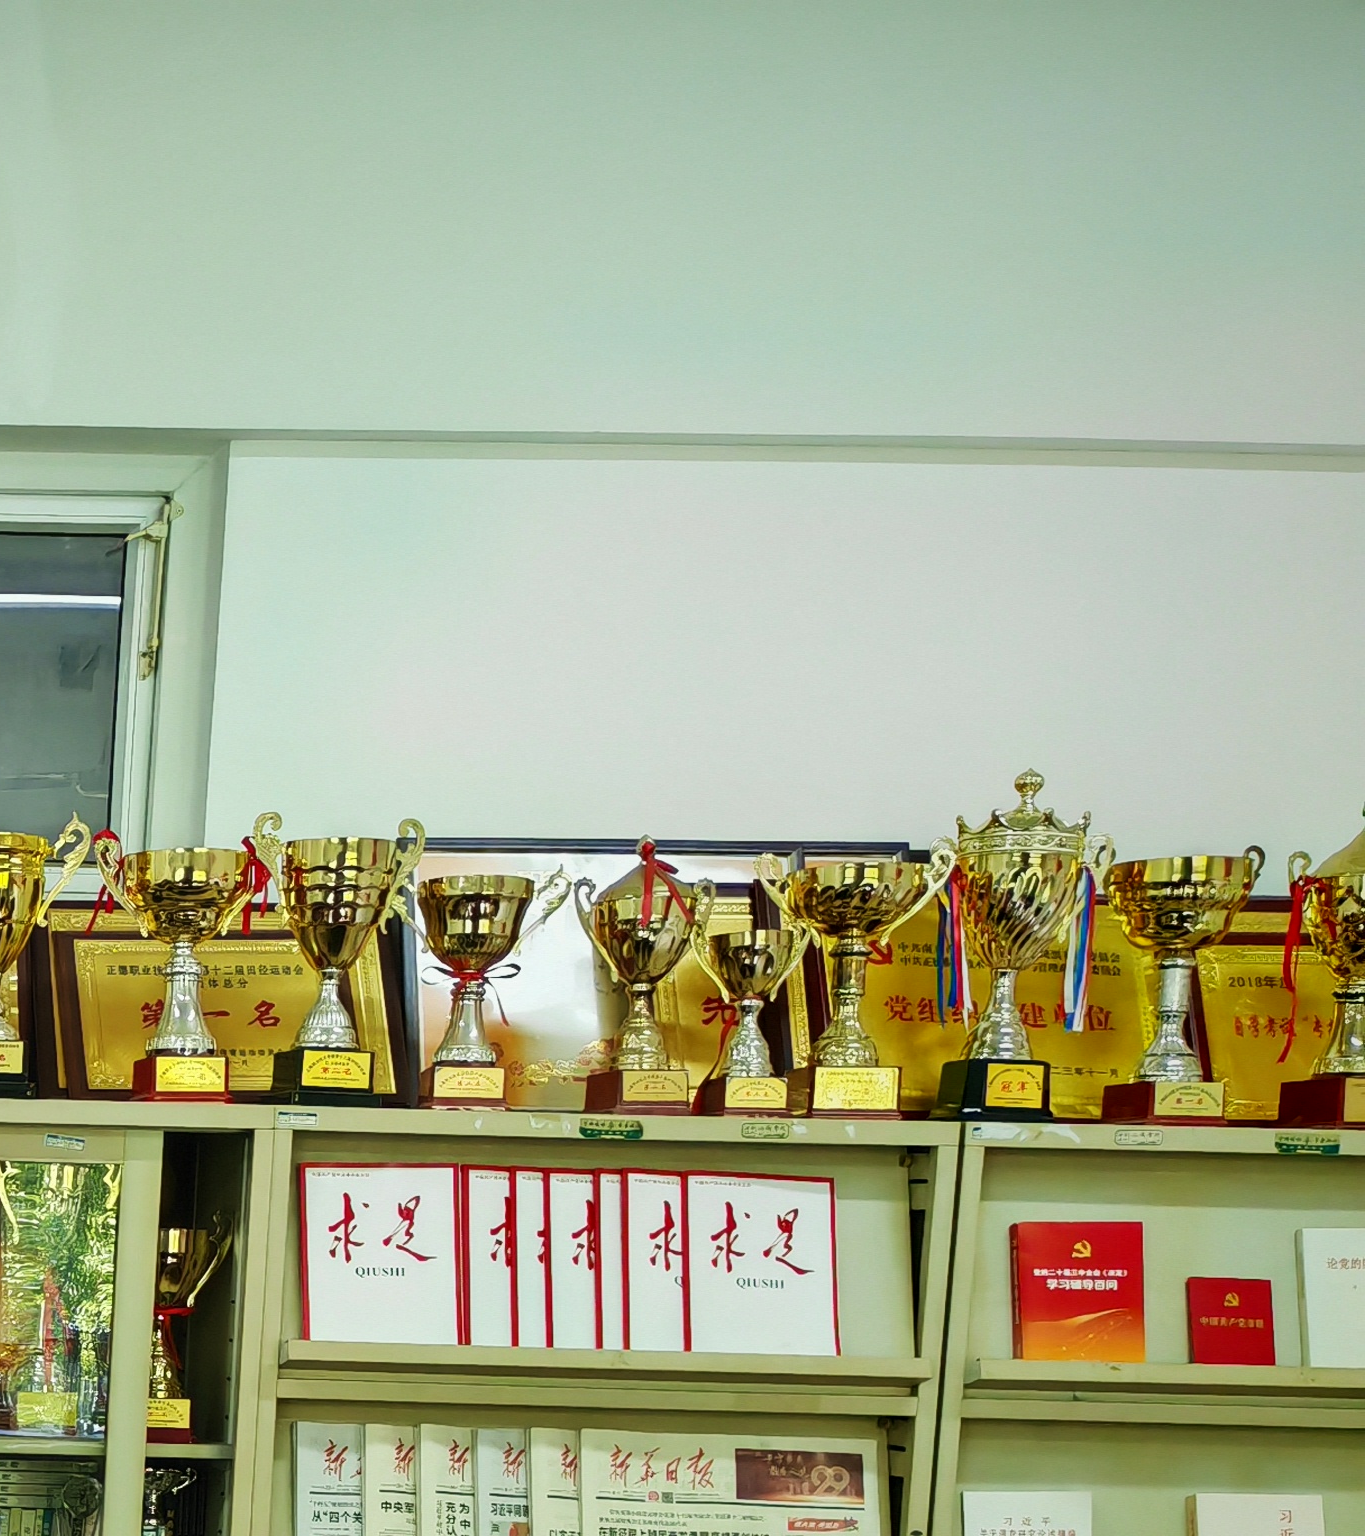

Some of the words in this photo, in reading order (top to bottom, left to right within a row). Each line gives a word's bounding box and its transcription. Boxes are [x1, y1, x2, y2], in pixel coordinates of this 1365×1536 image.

[141, 999, 282, 1029] 第一名
[328, 1191, 438, 1264] 求是
[709, 1201, 816, 1277] 求是
[355, 1266, 406, 1279] QIUSHI
[1326, 1256, 1365, 1271] 论党的
[735, 1276, 786, 1290] QIUSHI
[448, 1438, 470, 1482] 新
[502, 1441, 527, 1485] 新
[609, 1443, 716, 1491] 新华日报
[1003, 1516, 1052, 1527] 习近平
